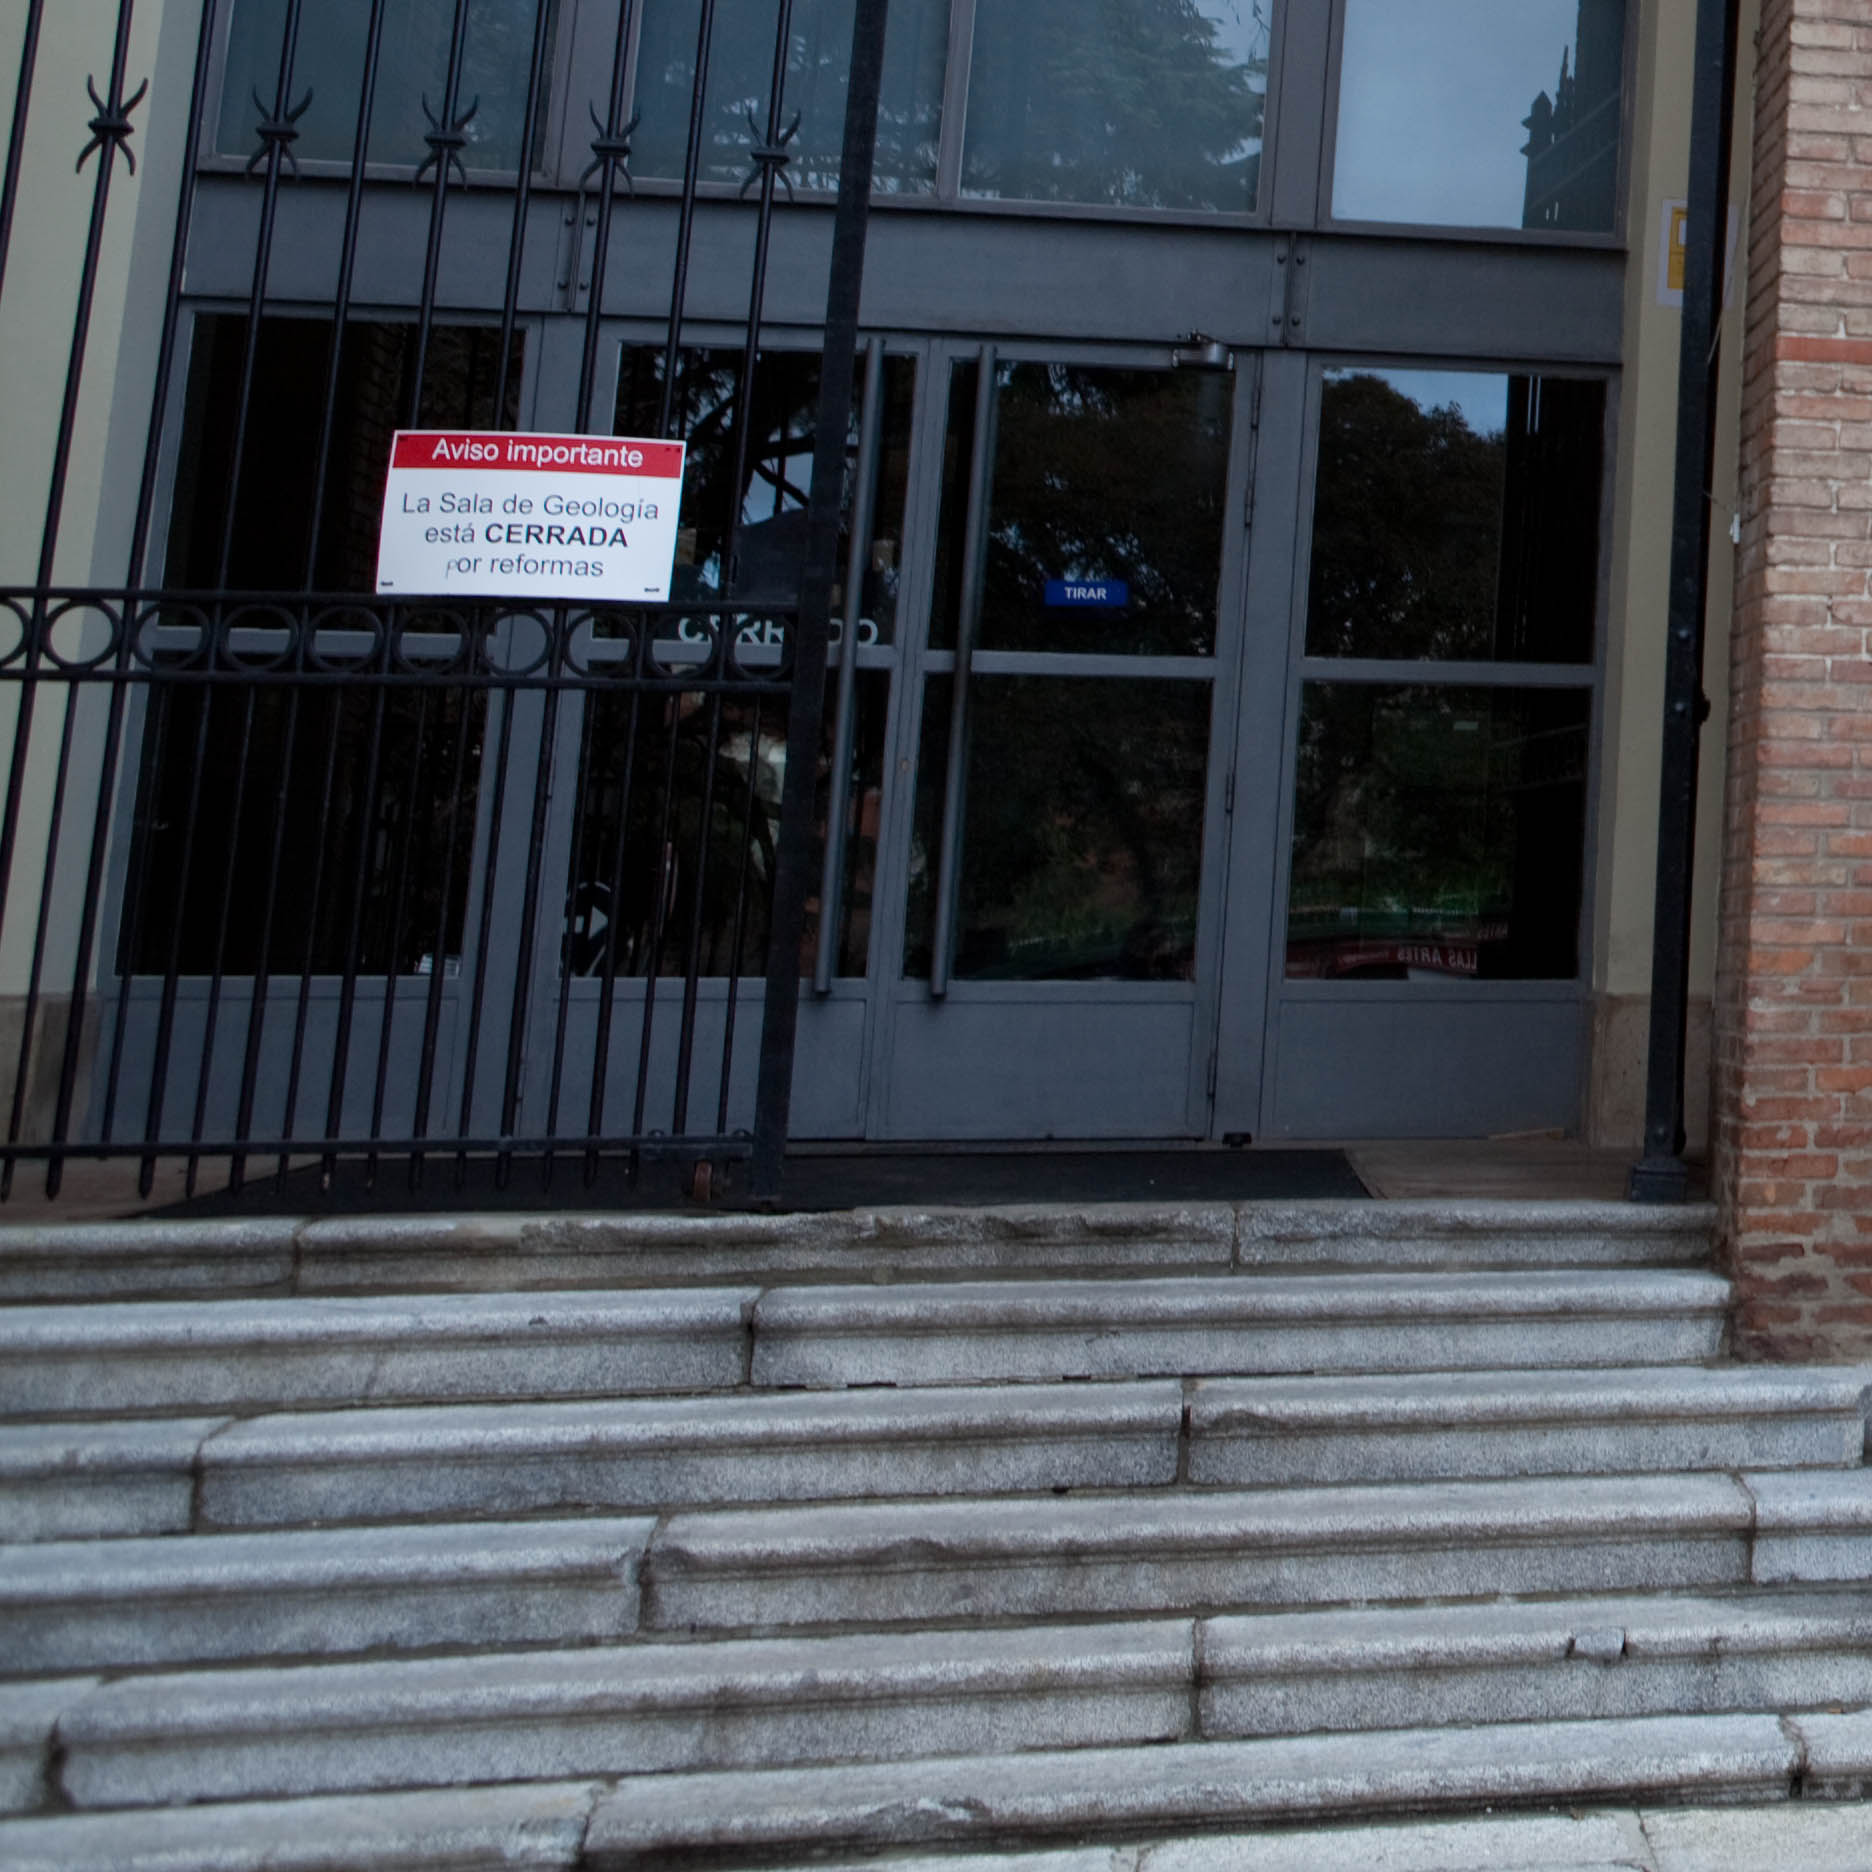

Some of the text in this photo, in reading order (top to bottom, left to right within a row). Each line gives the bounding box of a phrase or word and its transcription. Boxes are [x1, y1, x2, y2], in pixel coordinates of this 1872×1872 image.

[431, 437, 644, 469] Aviso importante
[402, 492, 431, 514] La
[439, 492, 493, 515] Sala
[502, 493, 533, 515] de
[424, 521, 629, 548] está CERRADA
[489, 553, 605, 578] reformas
[1063, 586, 1107, 600] TIRAR
